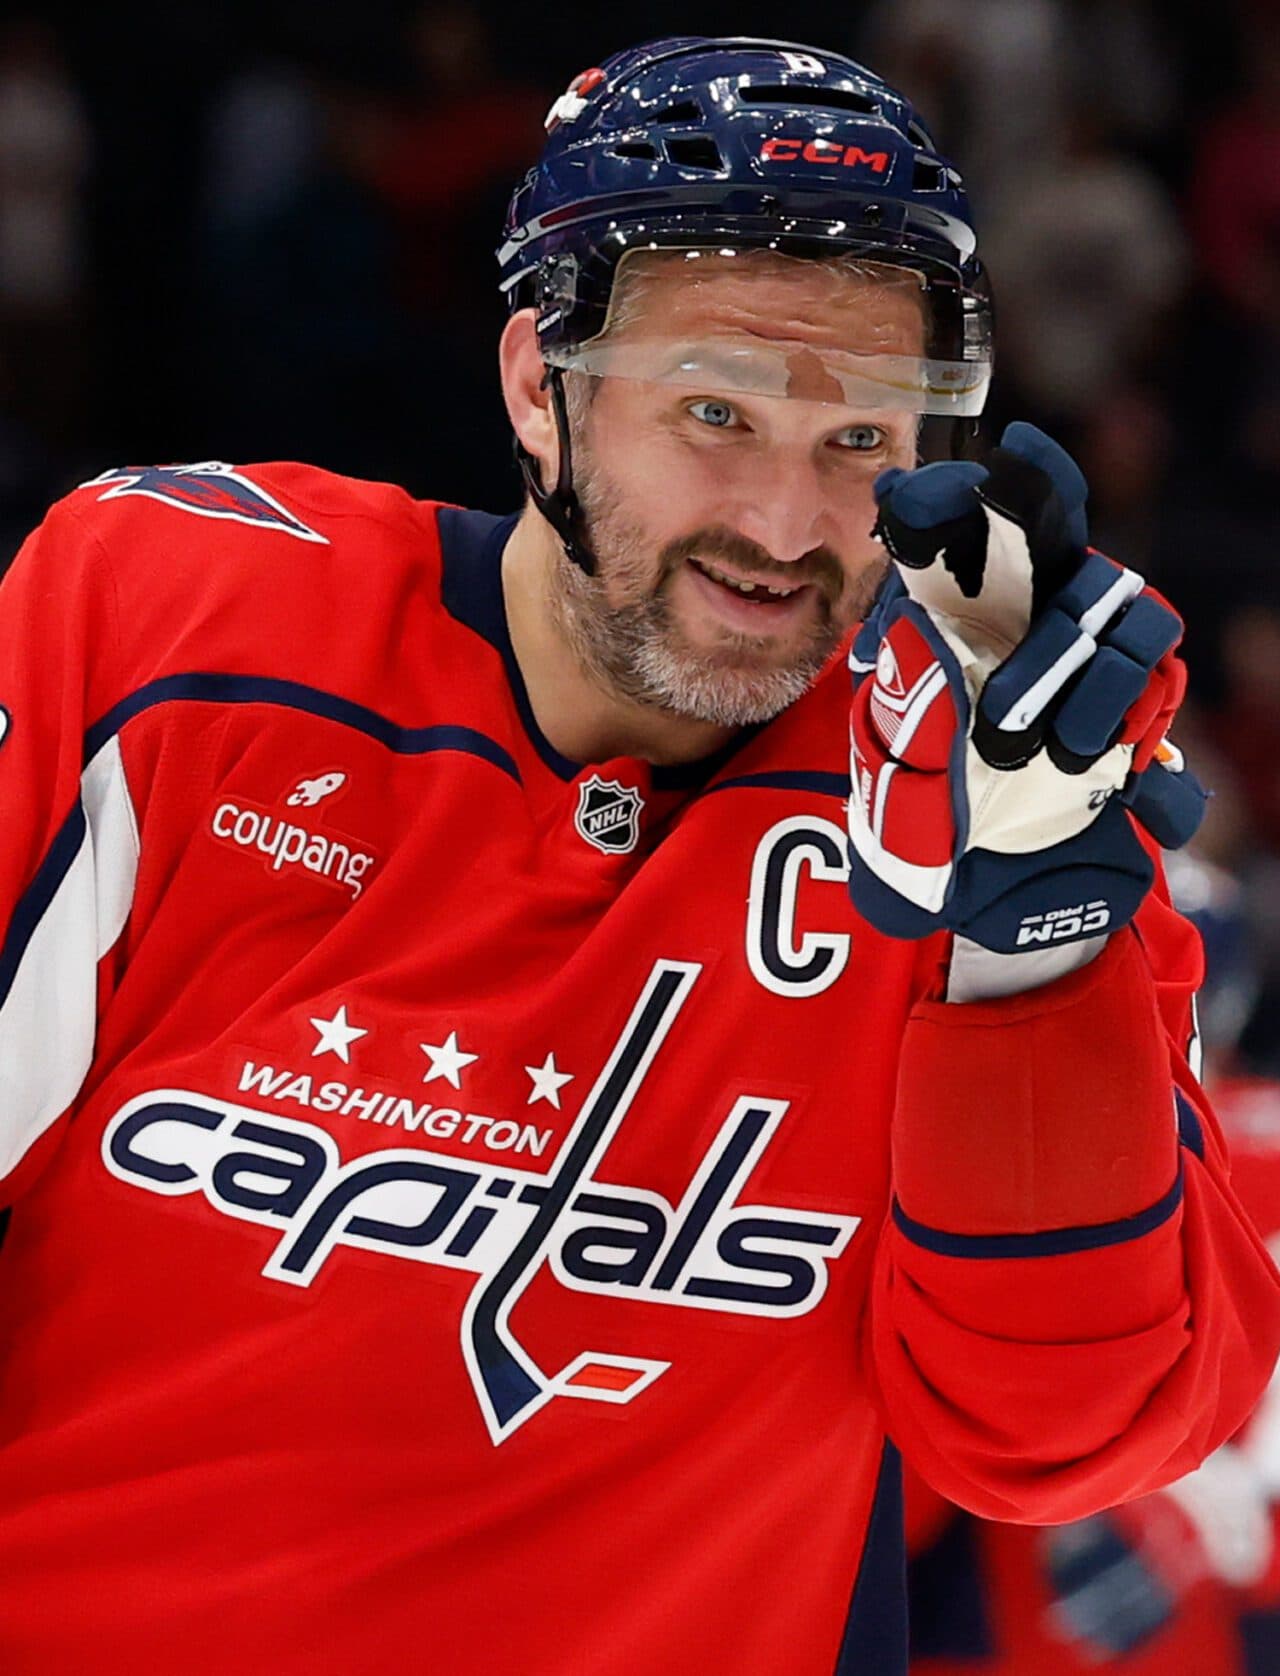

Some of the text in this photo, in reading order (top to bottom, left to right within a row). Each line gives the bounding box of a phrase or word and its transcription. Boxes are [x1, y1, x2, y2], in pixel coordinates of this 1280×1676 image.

[760, 138, 890, 173] CCM
[588, 803, 629, 833] NHL
[212, 803, 374, 900] coupang
[745, 815, 851, 998] C
[1016, 909, 1111, 946] CCM
[1045, 904, 1085, 922] PRO
[237, 1061, 554, 1157] WASHINGTON
[100, 958, 862, 1446] capitals
